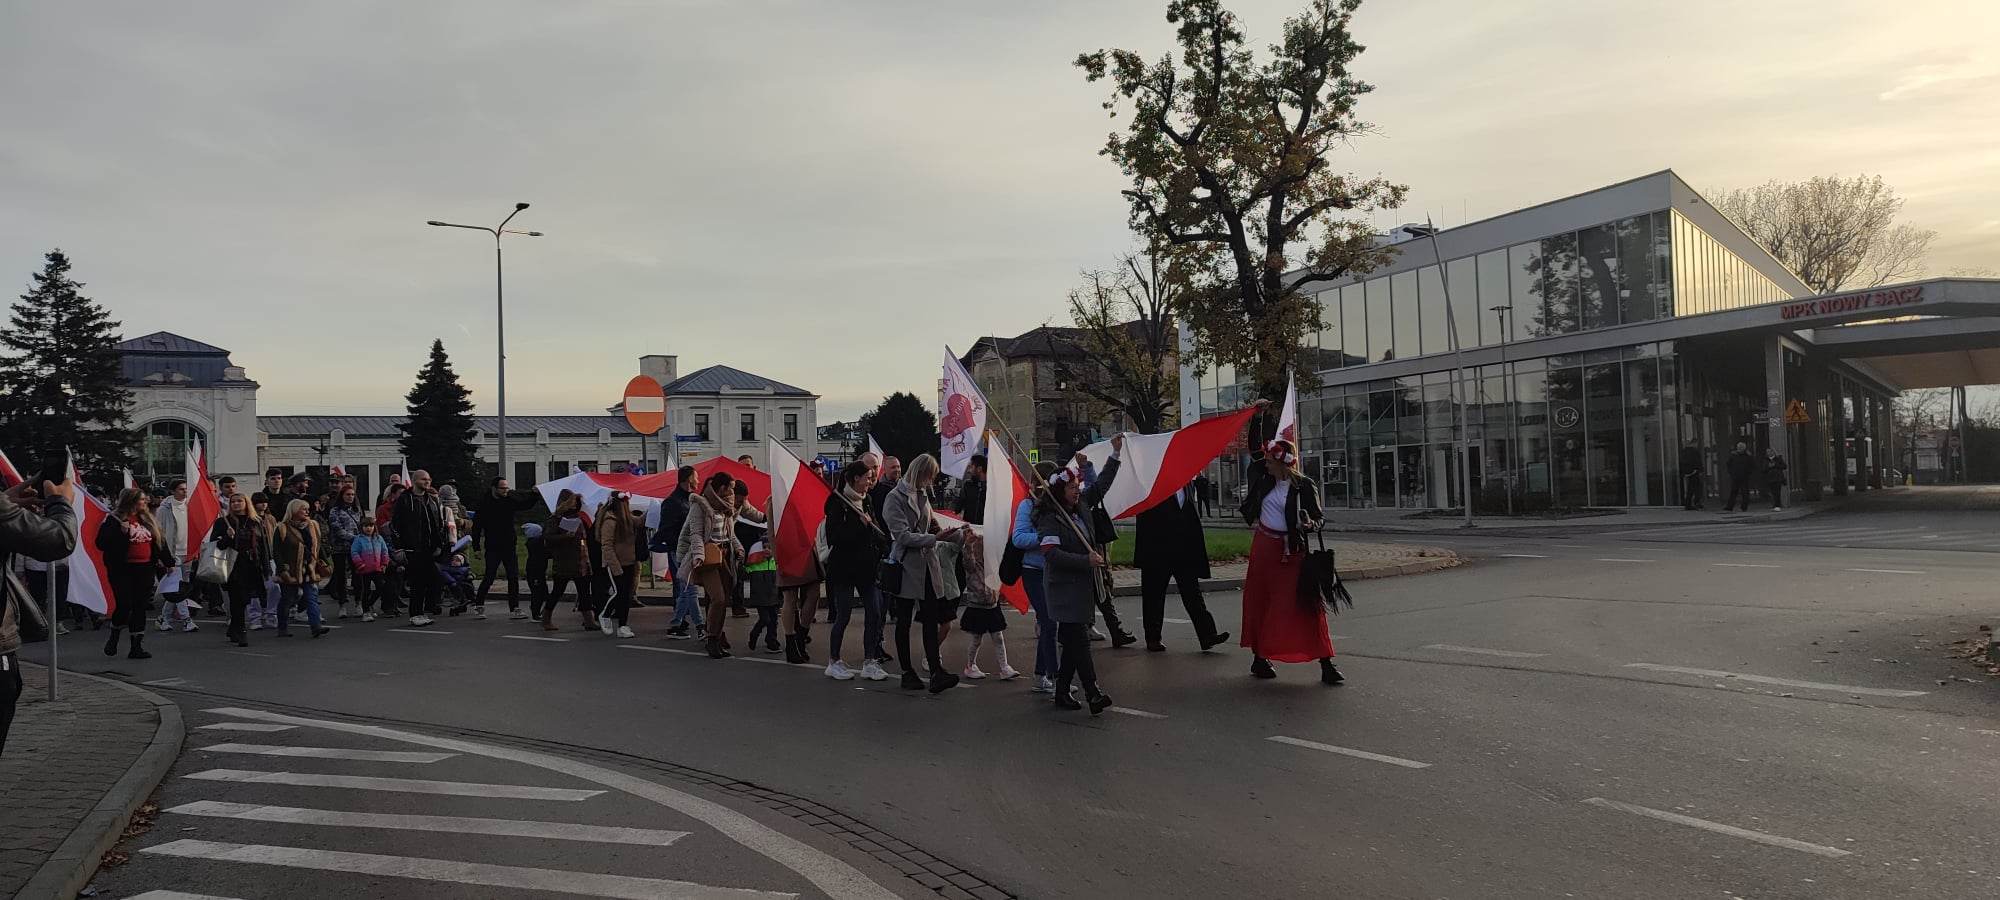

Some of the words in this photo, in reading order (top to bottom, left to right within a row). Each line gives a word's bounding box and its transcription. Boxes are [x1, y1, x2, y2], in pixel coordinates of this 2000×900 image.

[1780, 302, 1817, 319] MPK
[1818, 294, 1870, 314] NOWY
[1873, 286, 1924, 306] SĄCZ
